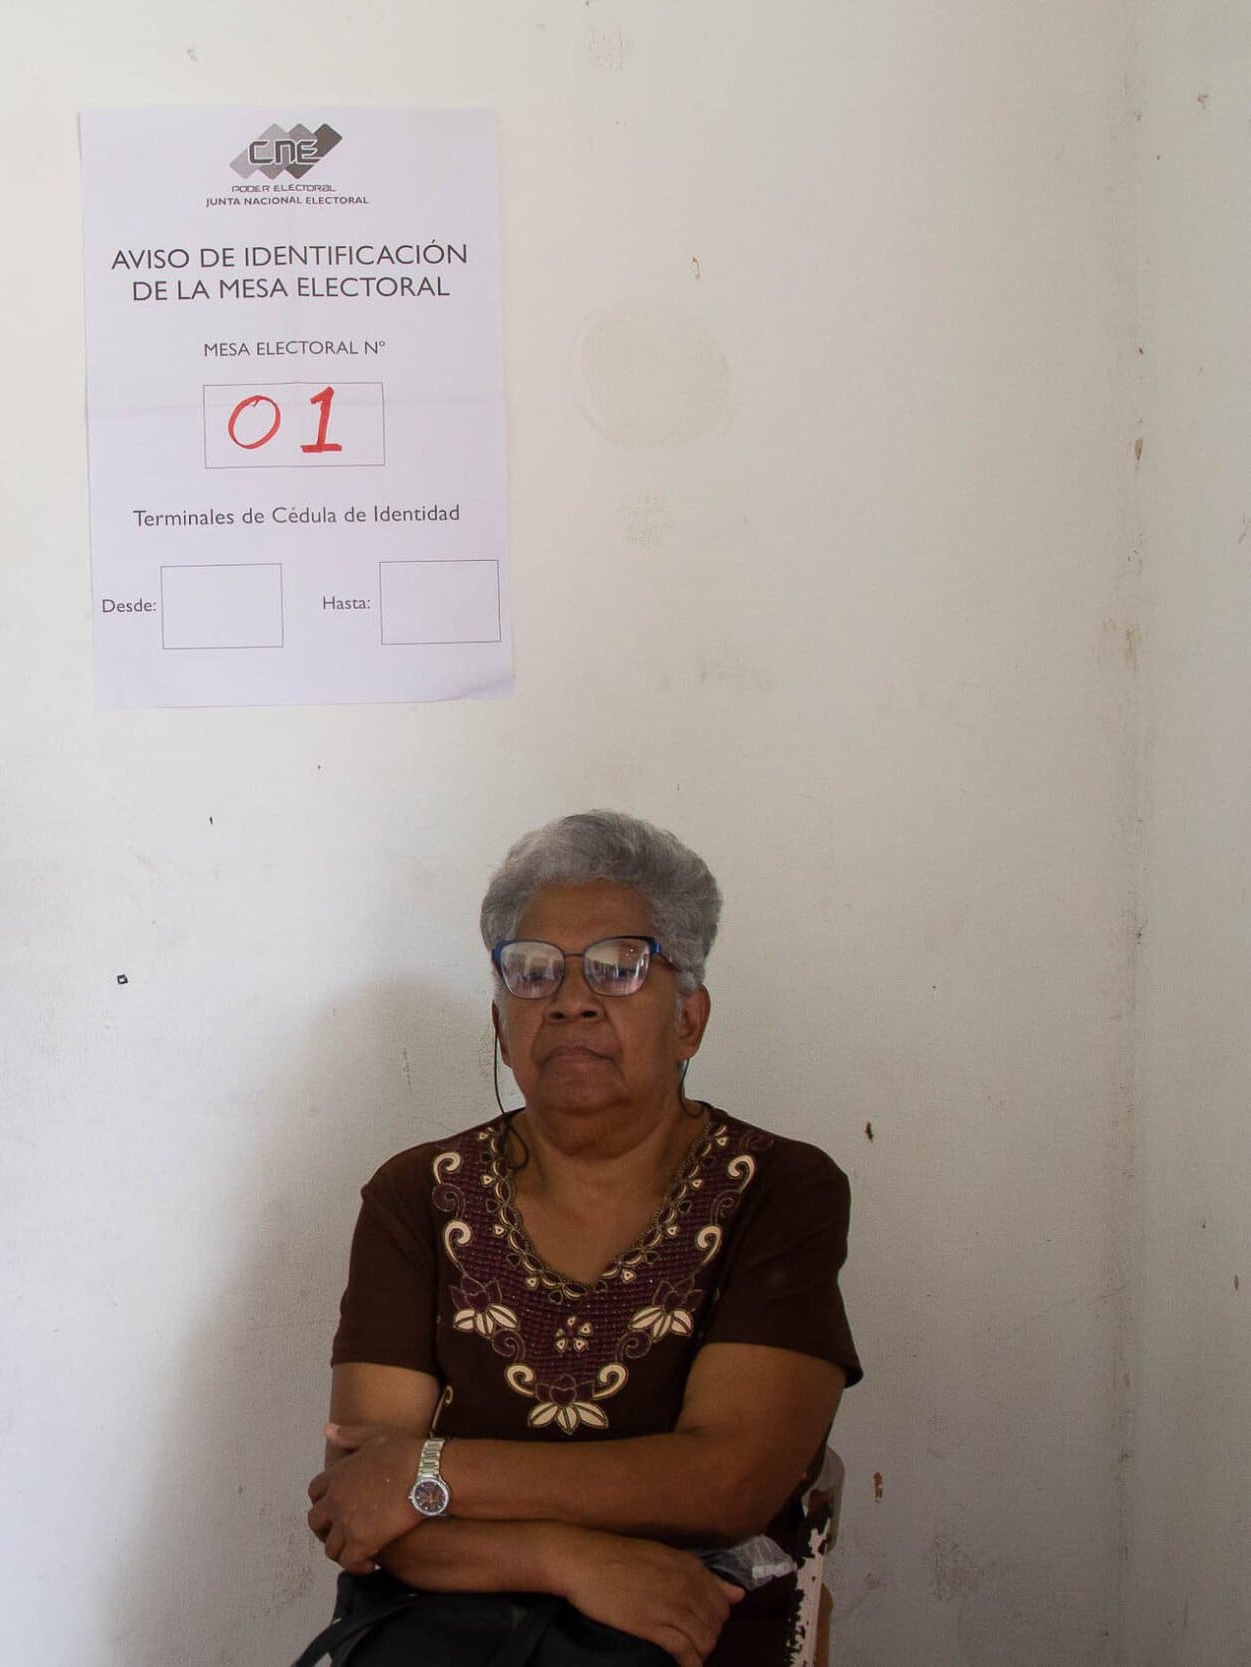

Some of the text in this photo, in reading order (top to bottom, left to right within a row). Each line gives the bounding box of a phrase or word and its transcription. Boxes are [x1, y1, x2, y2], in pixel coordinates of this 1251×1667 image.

[249, 140, 320, 164] CNE
[231, 184, 337, 193] PODER ELECTORAL
[206, 196, 370, 208] JUNTA NACIONAL ELECTORAL
[111, 239, 468, 270] AVISO DE IDENTIFICACIÓN
[133, 276, 451, 301] DE LA MESA ELECTORAL
[204, 342, 251, 357] MESA
[256, 340, 359, 356] ELECTORAL
[133, 504, 460, 528] Terminales de Cédula de Identidad
[102, 598, 158, 613] Desde:
[323, 596, 371, 611] Hasta:
